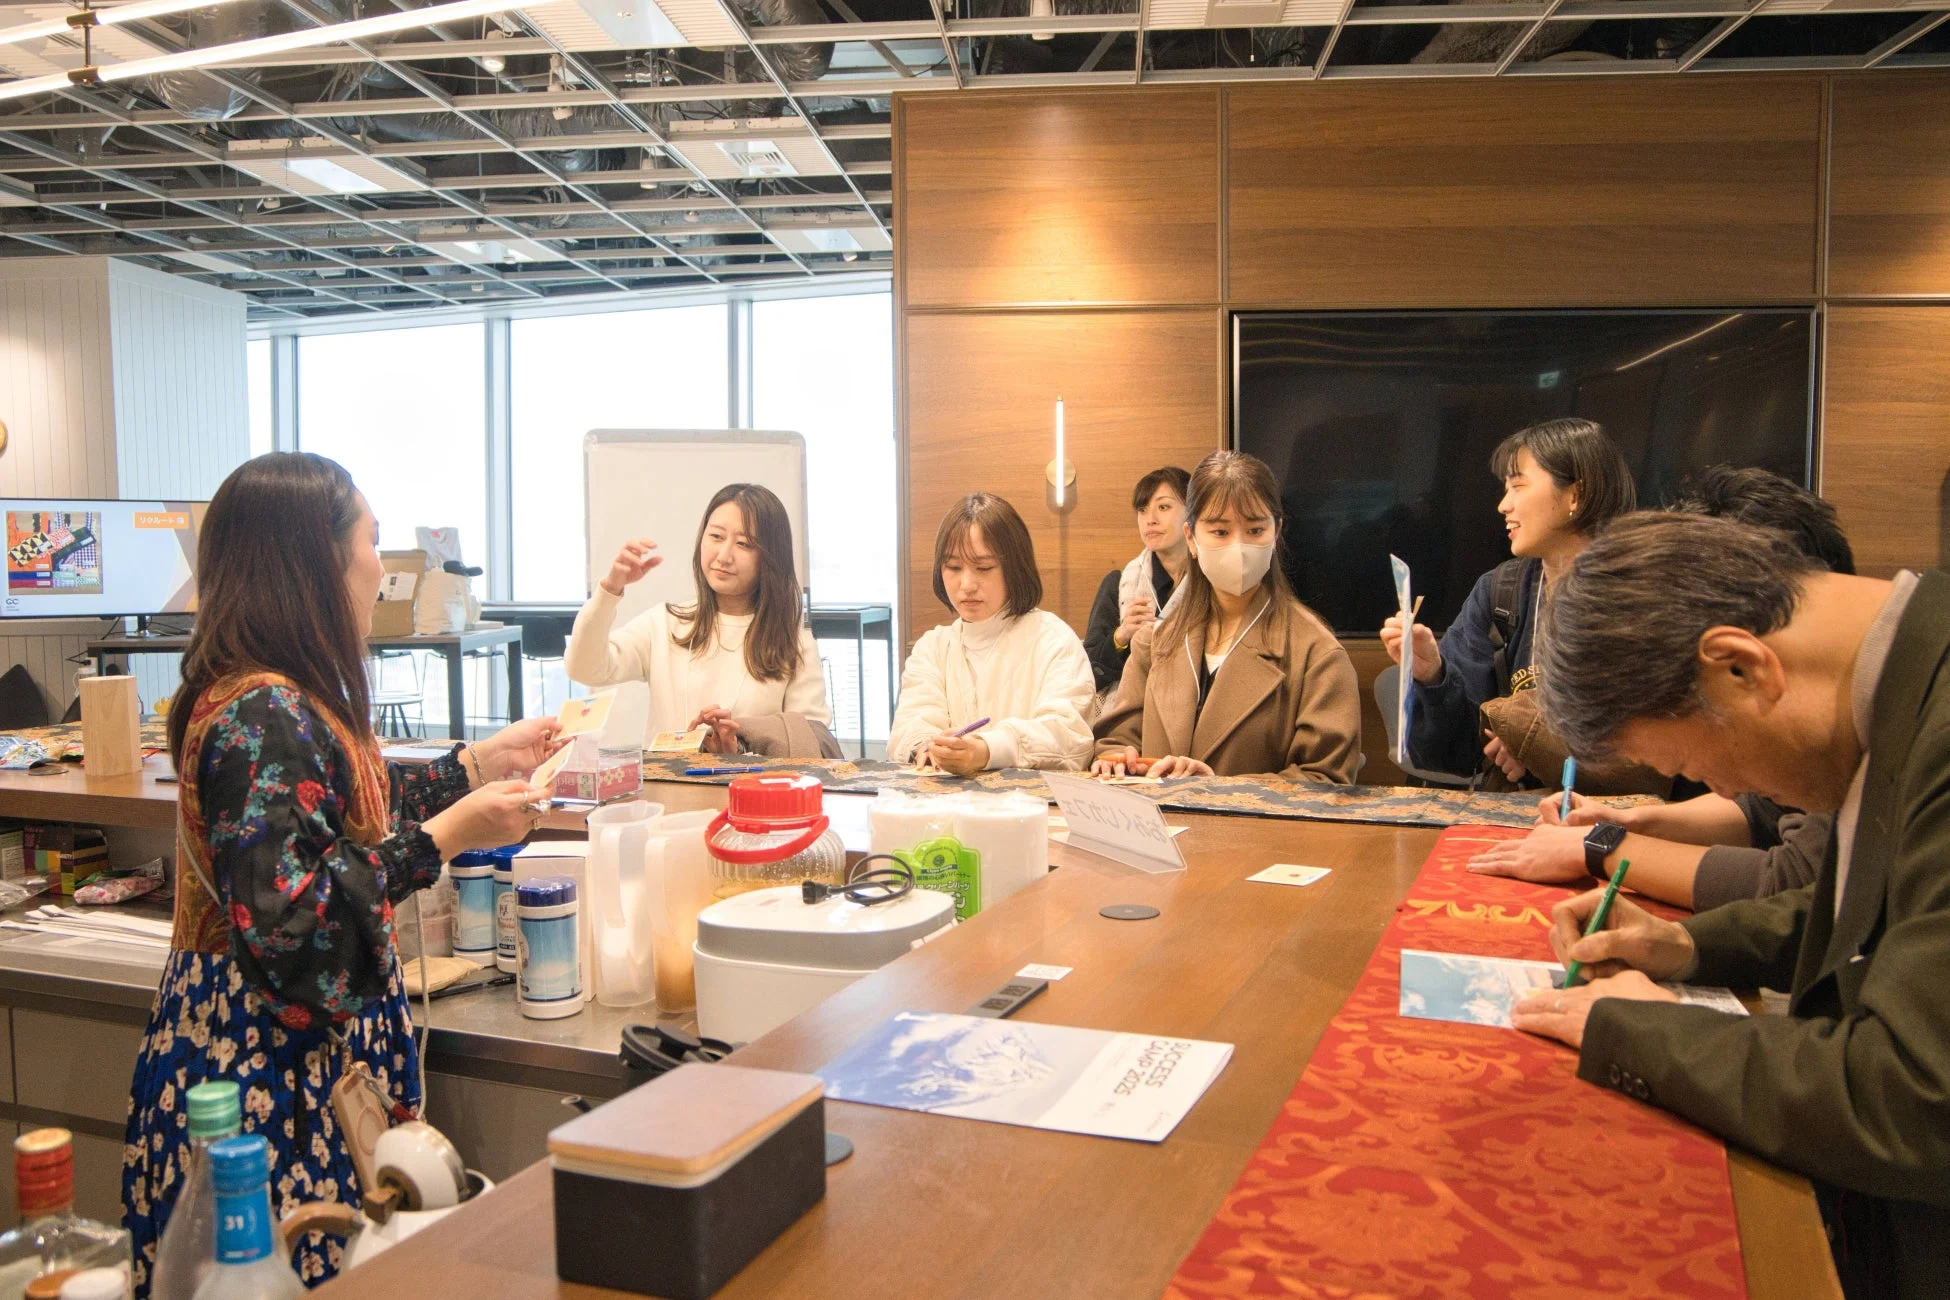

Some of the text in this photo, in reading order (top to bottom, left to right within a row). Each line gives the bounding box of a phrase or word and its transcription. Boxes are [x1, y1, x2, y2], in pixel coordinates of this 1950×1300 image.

[1138, 1040, 1170, 1068] CAMP
[1145, 1042, 1192, 1088] SUCCESS
[1113, 1068, 1147, 1095] 2025
[224, 1214, 245, 1231] 31
